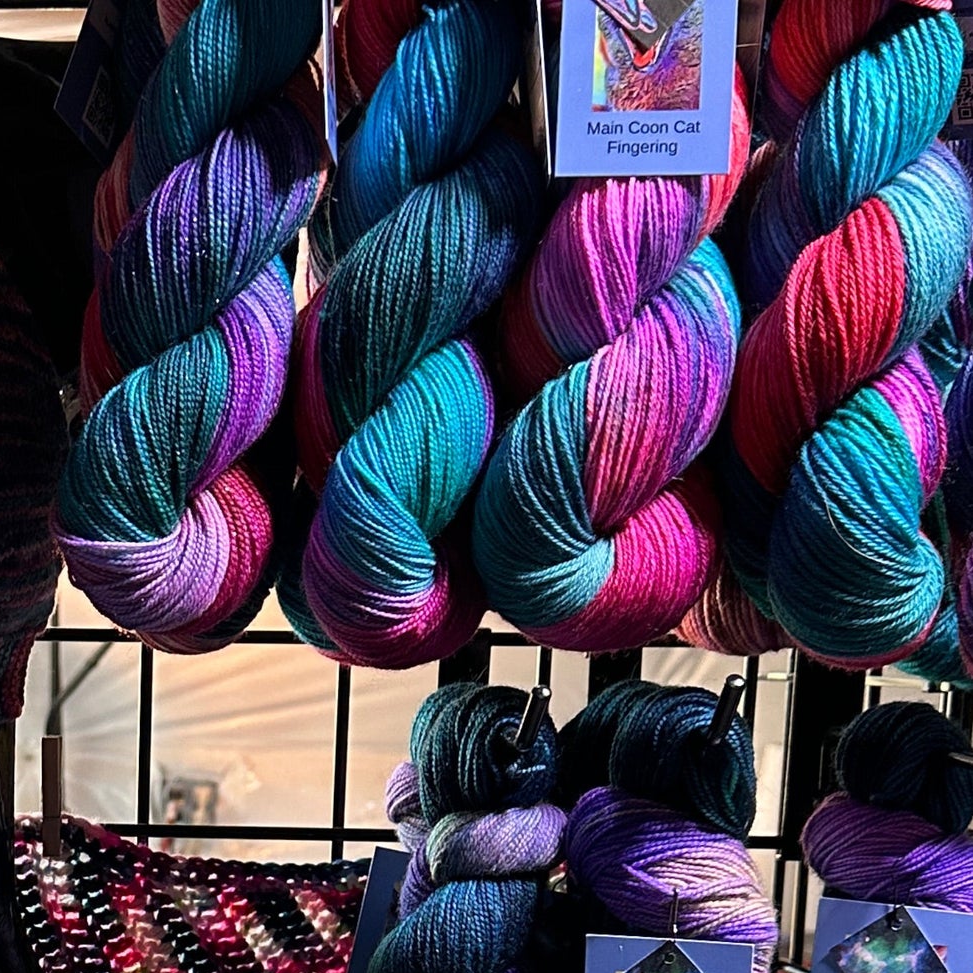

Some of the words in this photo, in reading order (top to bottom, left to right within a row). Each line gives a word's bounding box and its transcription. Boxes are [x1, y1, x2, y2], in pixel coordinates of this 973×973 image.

[587, 121, 623, 135] Main
[628, 121, 669, 135] Coon
[673, 120, 701, 134] Cat
[607, 140, 678, 157] Fingering
